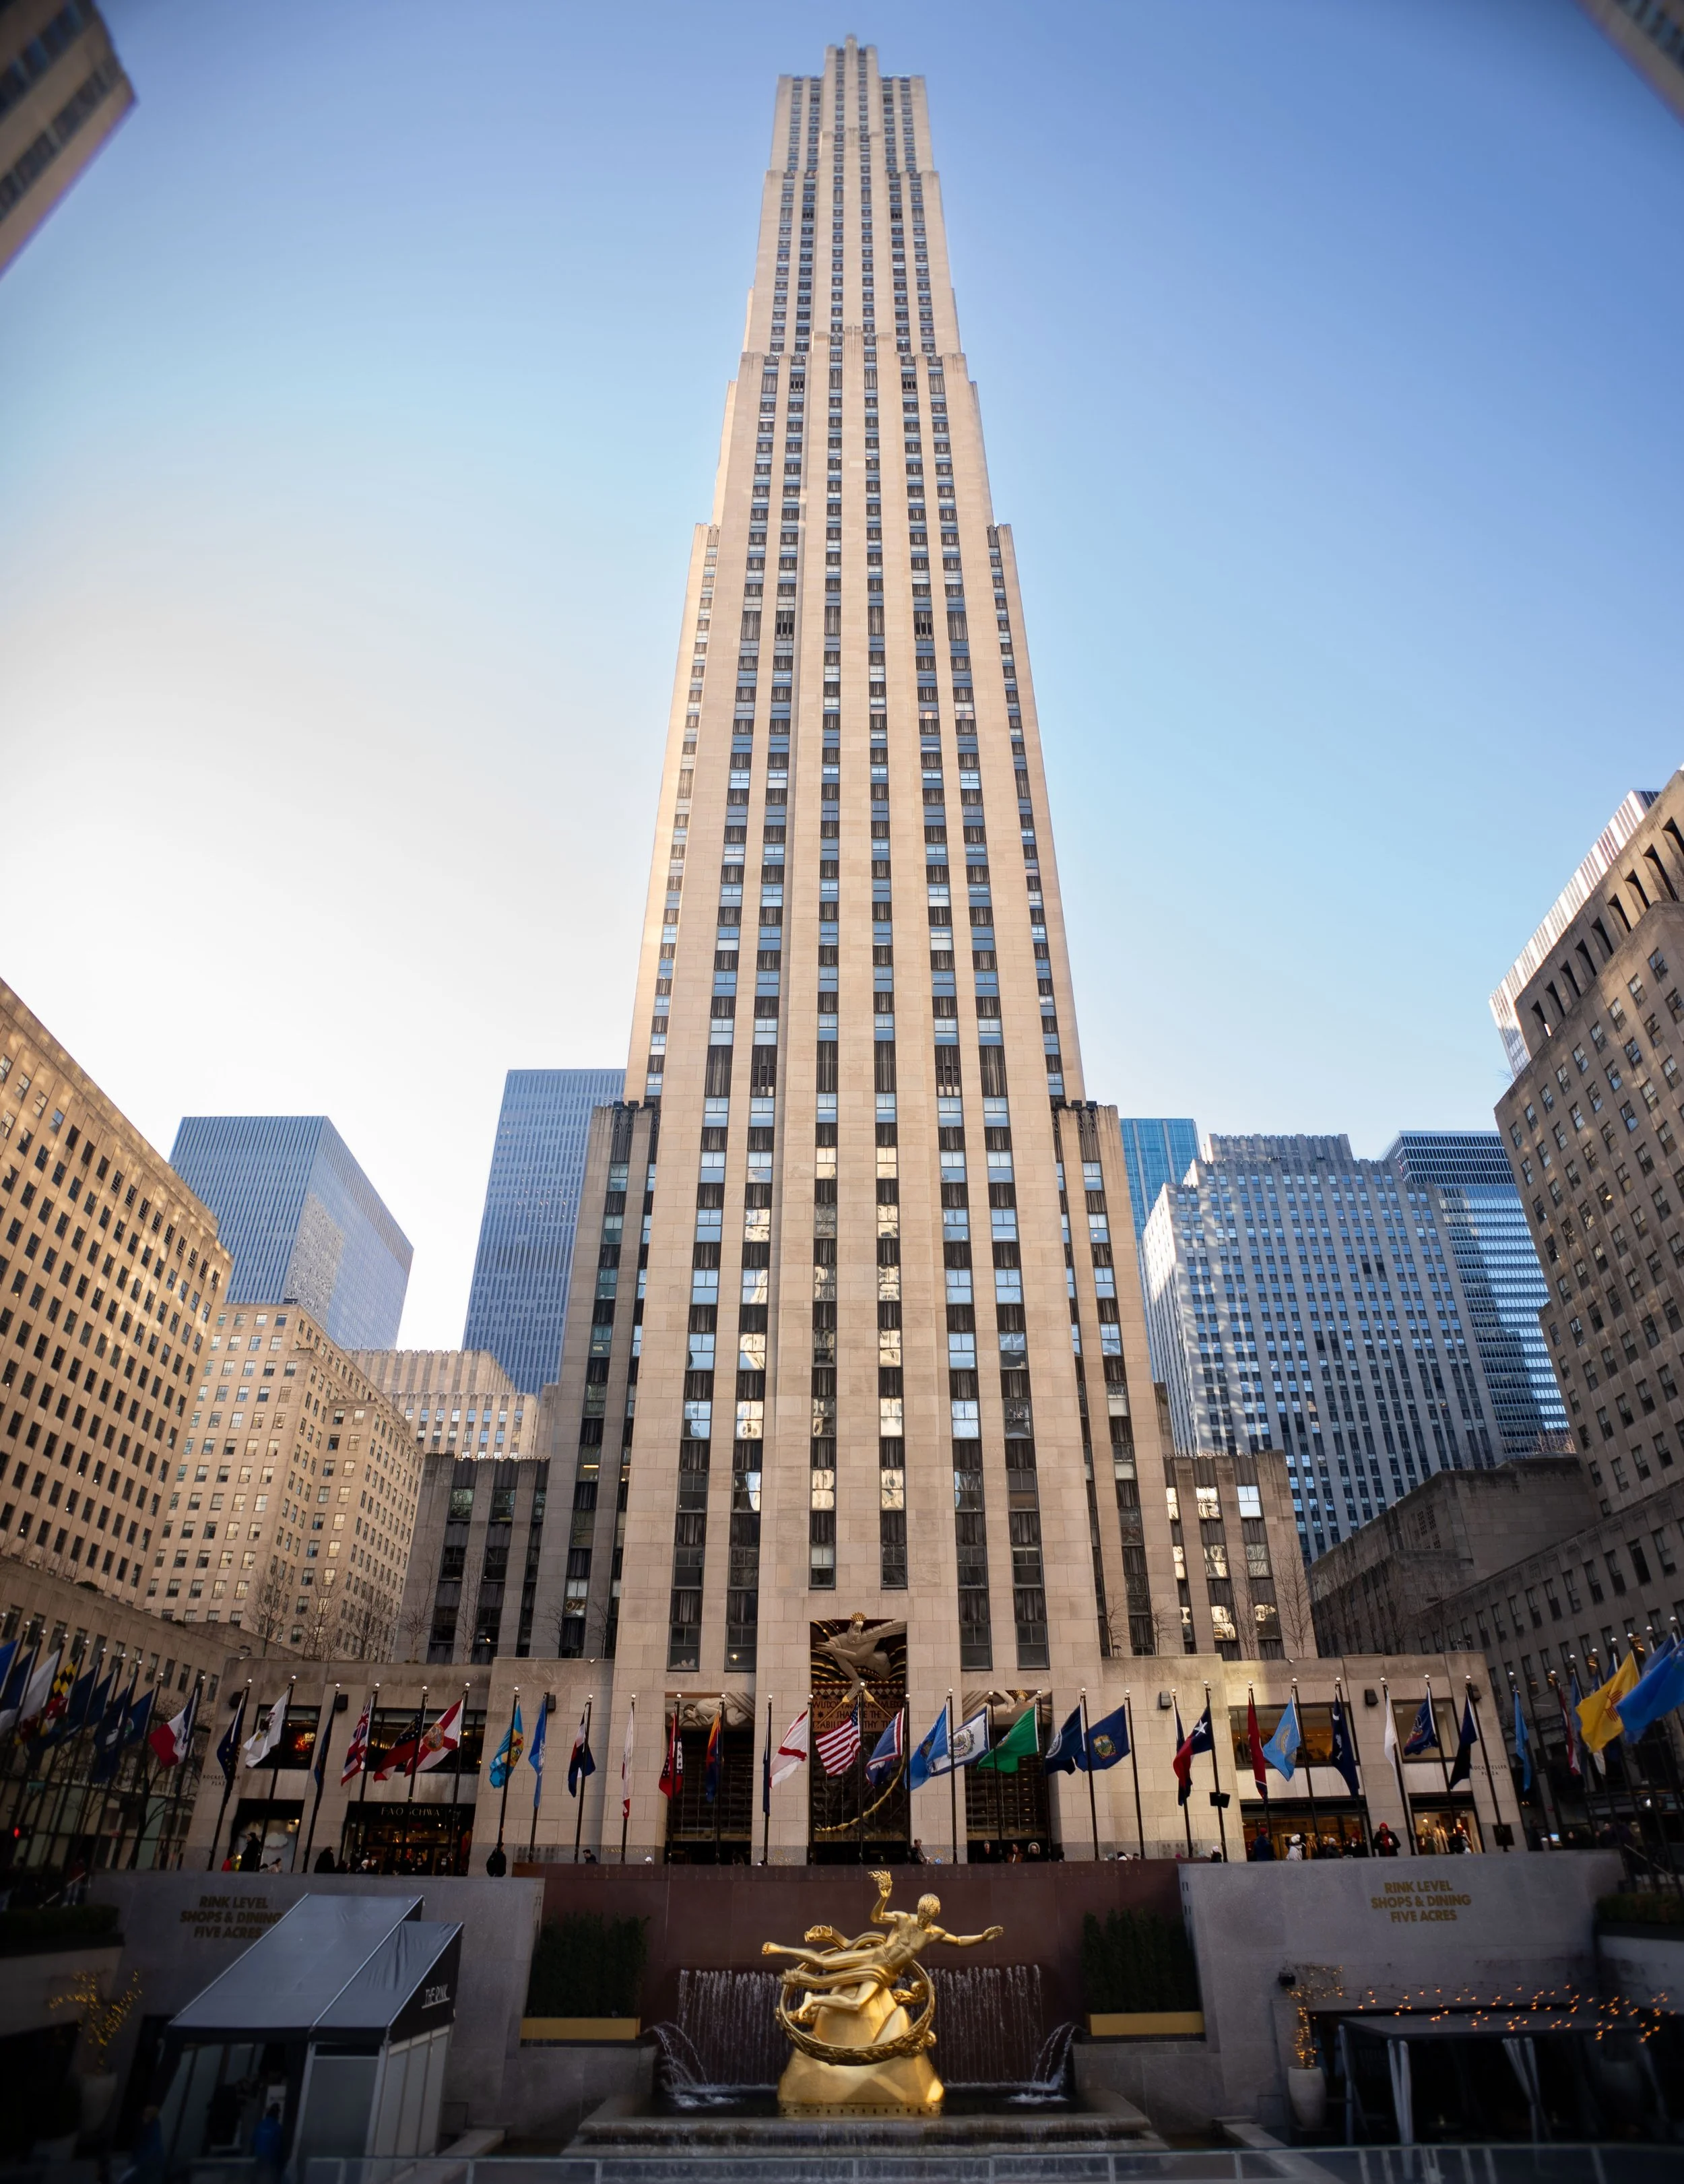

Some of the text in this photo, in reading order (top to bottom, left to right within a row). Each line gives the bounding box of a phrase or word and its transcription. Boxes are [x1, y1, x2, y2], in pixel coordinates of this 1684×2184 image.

[870, 1710, 881, 1719] THE
[865, 1720, 878, 1729] THY
[1384, 1880, 1454, 1894] RINK LEVEL
[199, 1895, 269, 1909] RINK LEVEL
[1371, 1894, 1472, 1909] SHOPS & DINING
[180, 1910, 283, 1924] SHOPS & DINING
[1390, 1909, 1458, 1923] FIVE ACRES
[193, 1926, 263, 1939] FIVE ACRES
